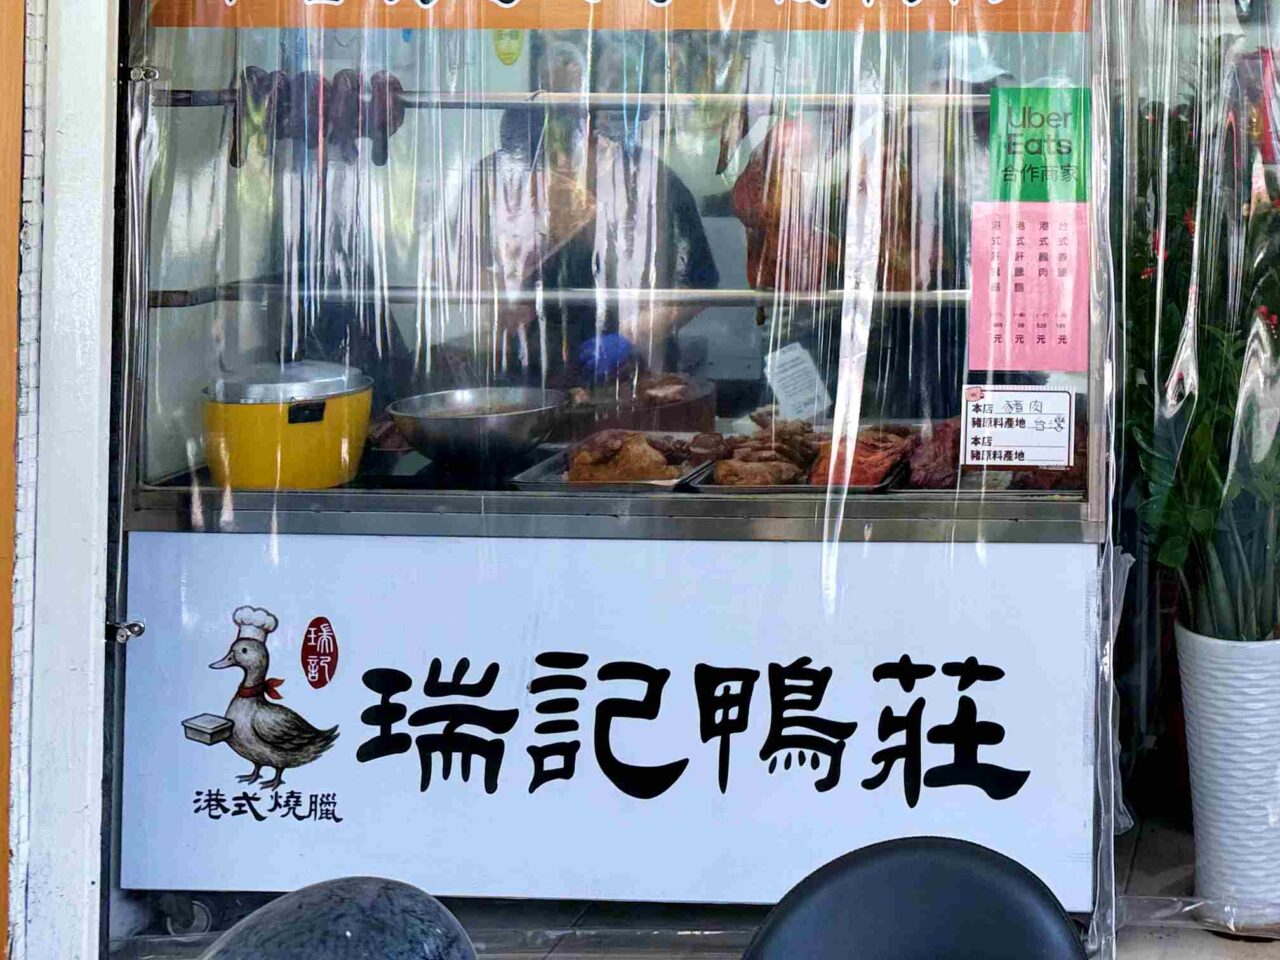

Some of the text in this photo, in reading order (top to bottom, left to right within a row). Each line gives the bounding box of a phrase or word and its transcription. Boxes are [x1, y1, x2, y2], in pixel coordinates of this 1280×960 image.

[1007, 106, 1073, 128] Uber
[1007, 132, 1073, 156] Eats
[1002, 163, 1079, 183] 合作商家
[971, 402, 994, 414] 本店
[970, 435, 993, 447] 本店
[355, 650, 1032, 810] 瑞記鴨莊
[193, 788, 344, 824] 港式燒臘
